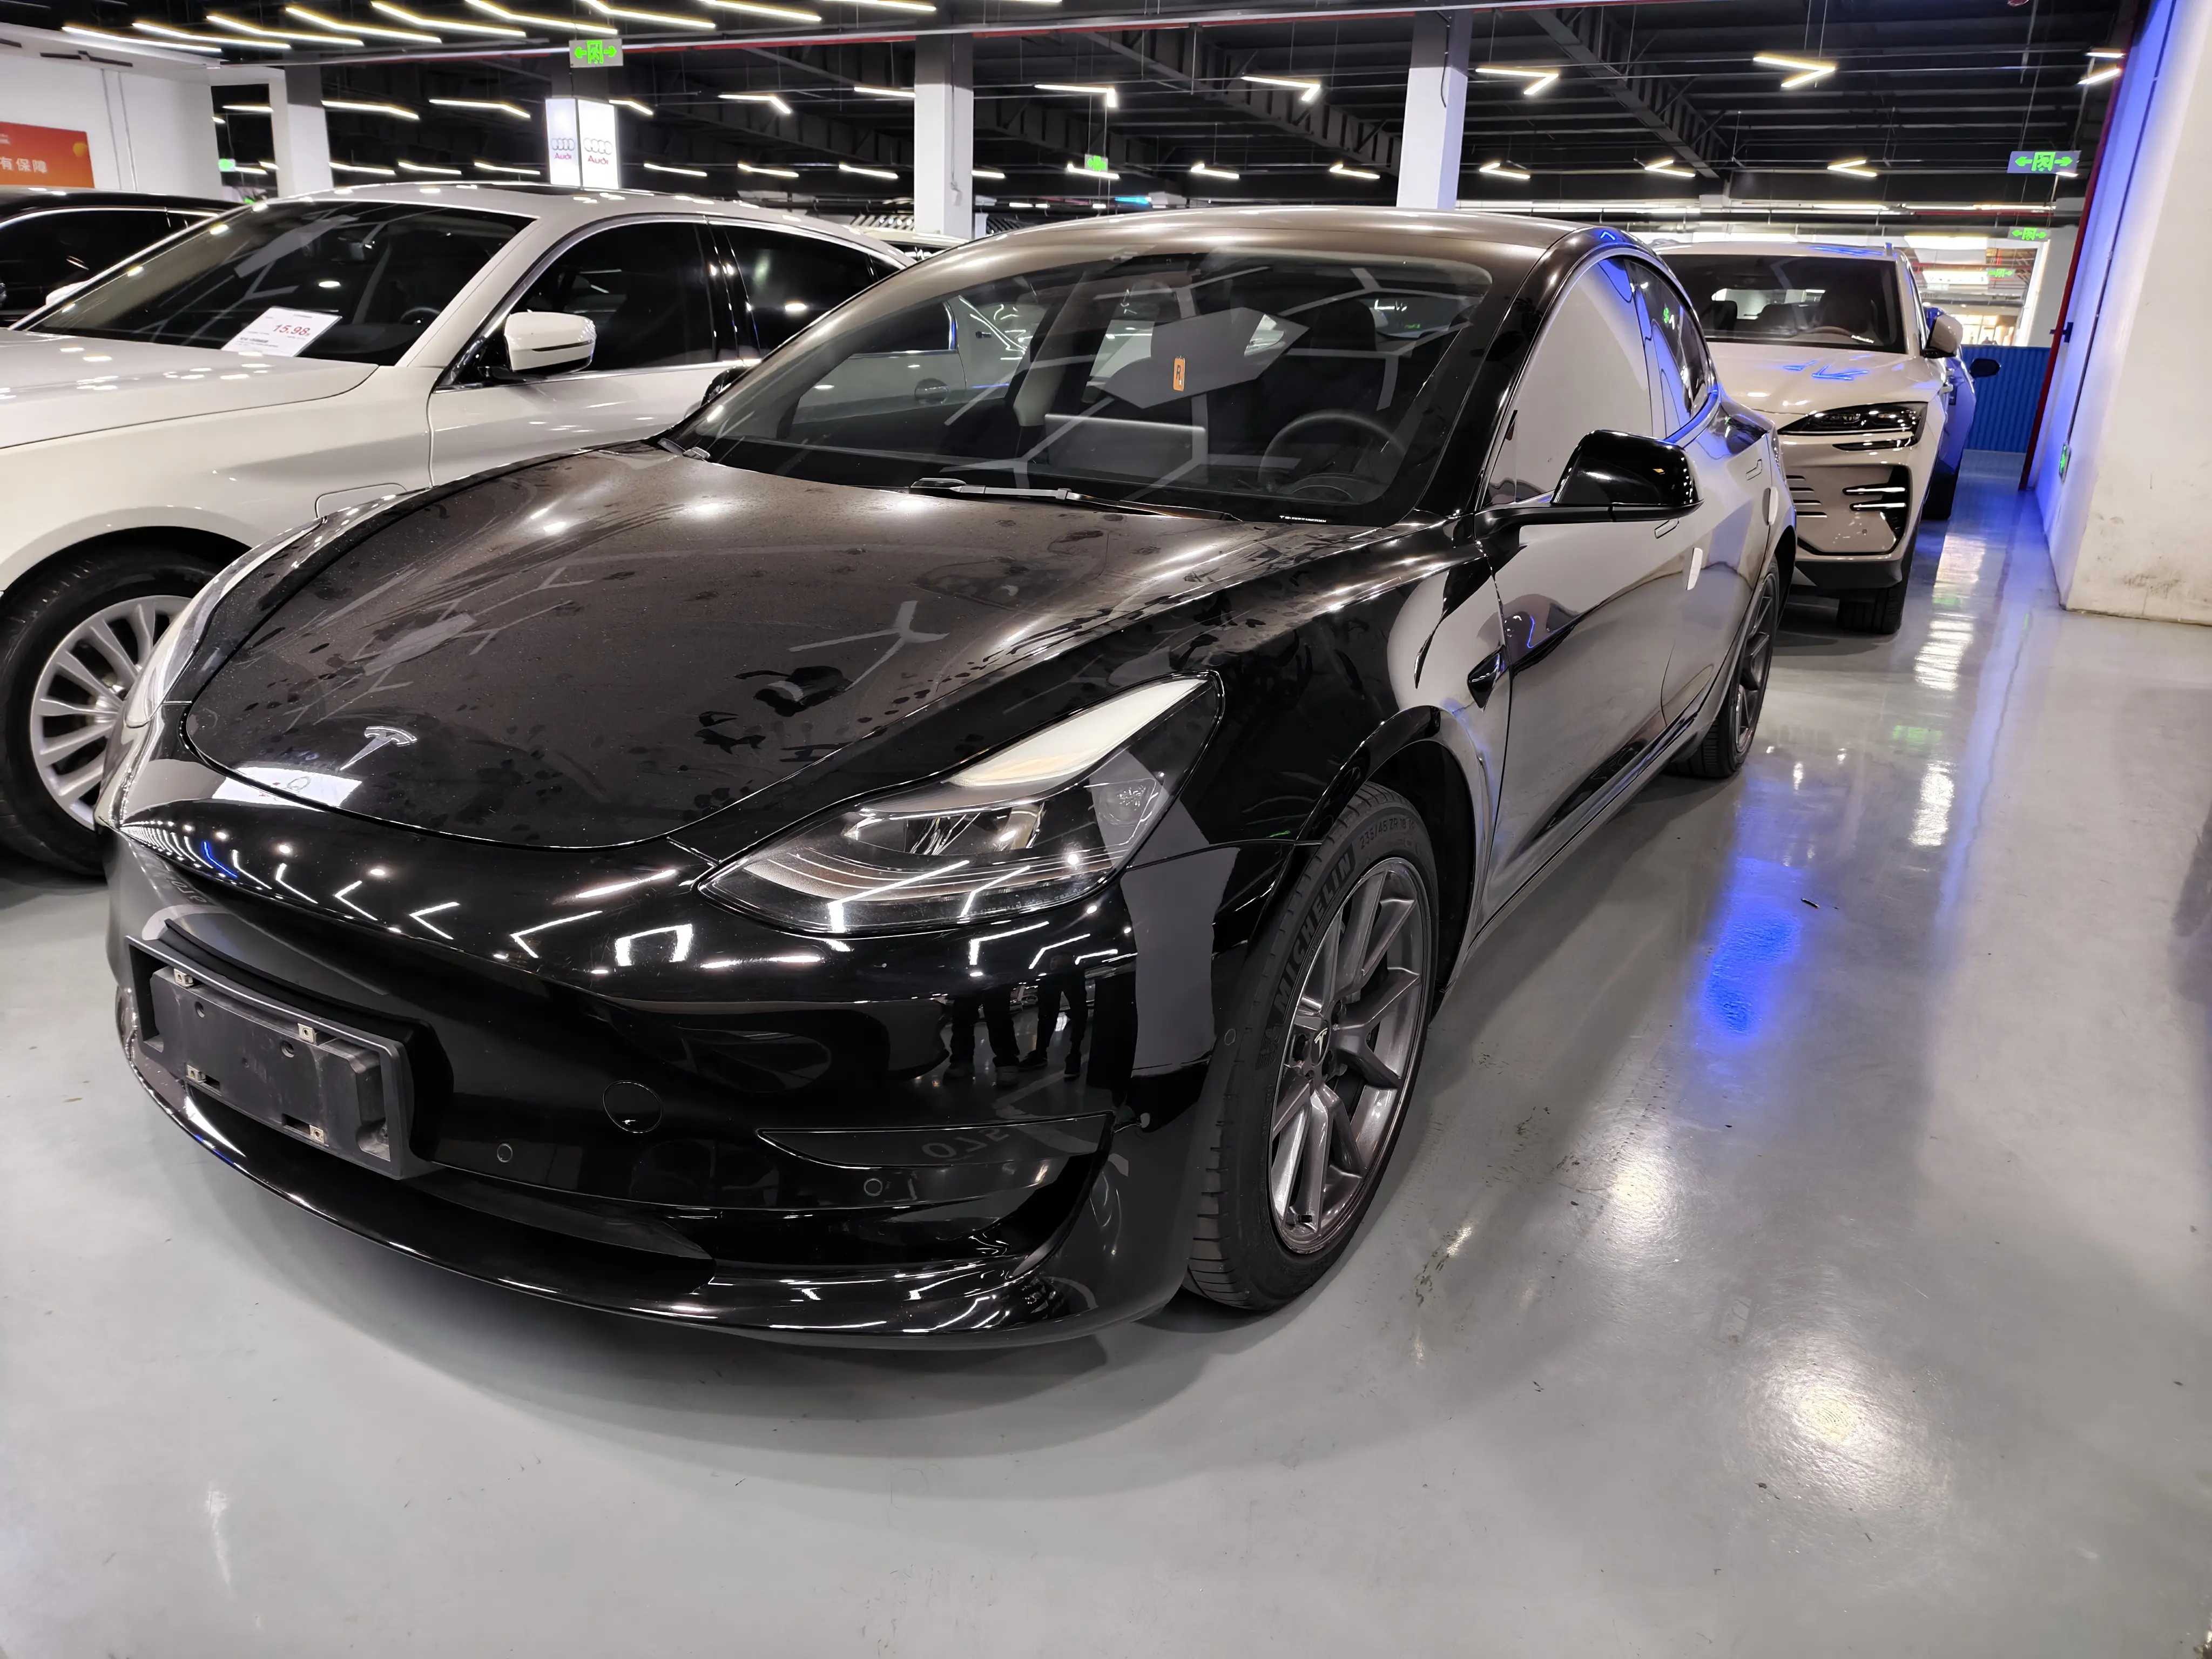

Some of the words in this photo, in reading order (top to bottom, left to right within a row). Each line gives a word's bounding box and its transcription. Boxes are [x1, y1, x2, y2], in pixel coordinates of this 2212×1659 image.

[0, 157, 48, 173] 有保障
[588, 154, 609, 165] Audi
[1360, 820, 1387, 850] 235/45
[1389, 818, 1398, 830] ZR
[1400, 818, 1406, 830] 18
[1273, 852, 1351, 1014] MICHELIN
